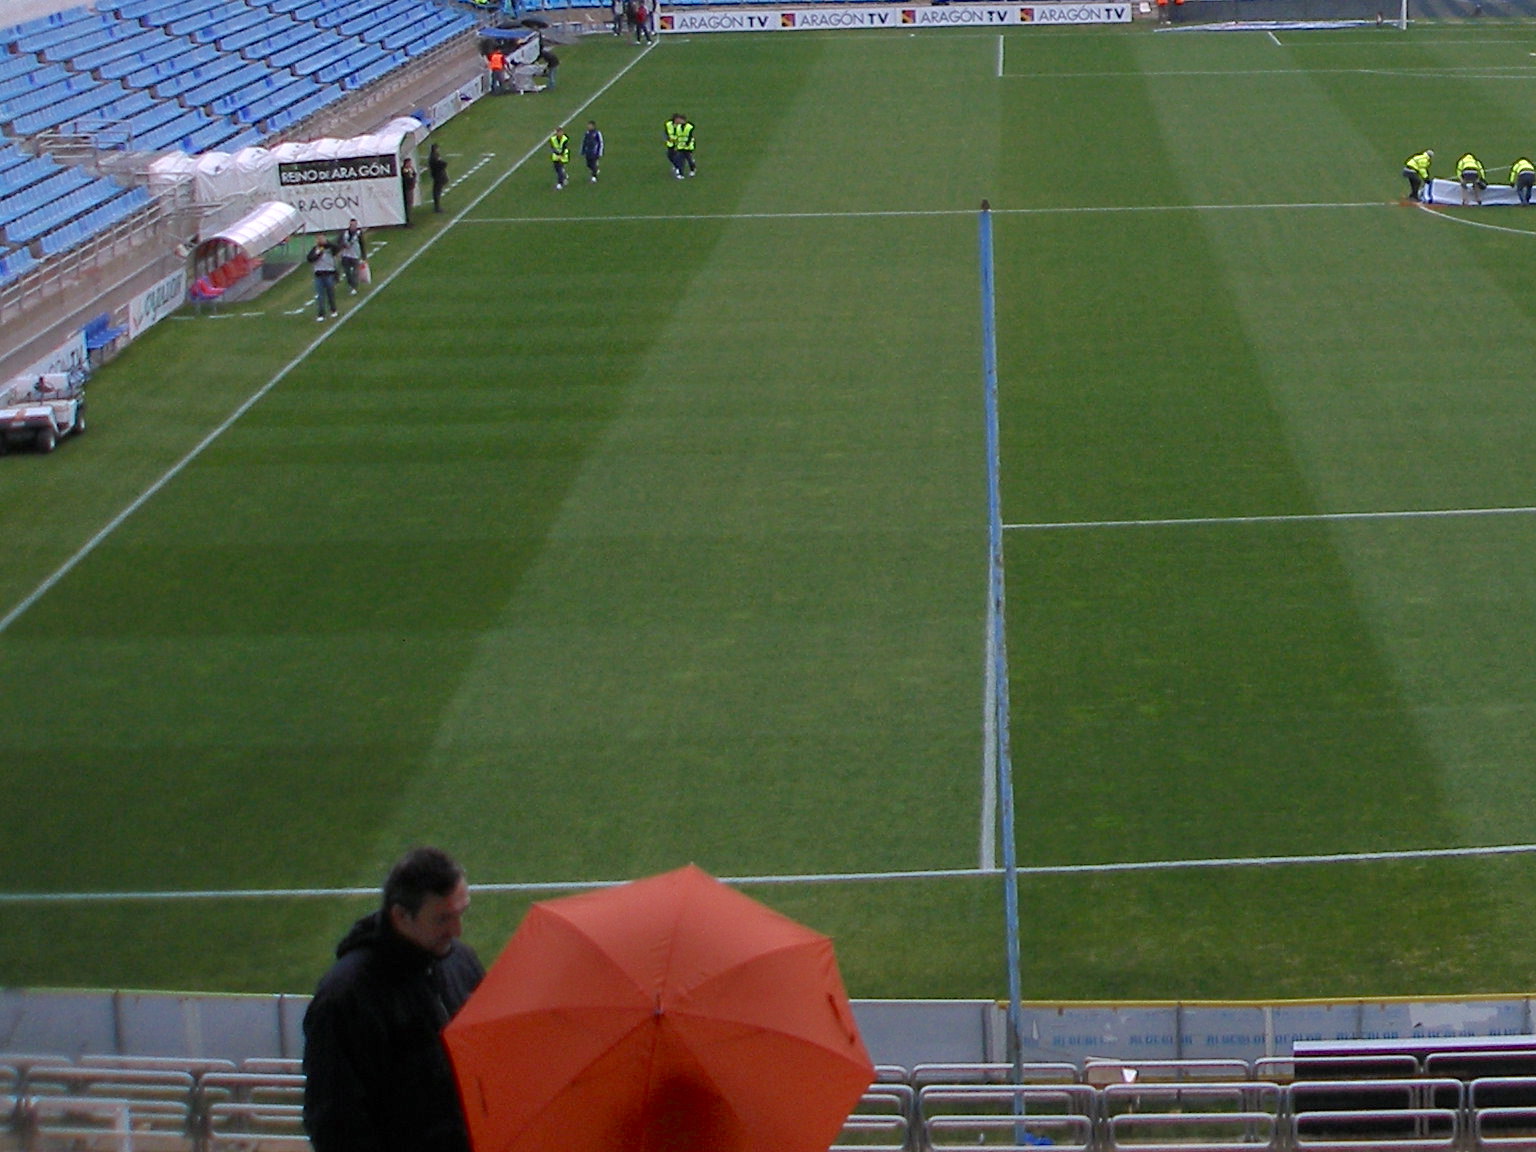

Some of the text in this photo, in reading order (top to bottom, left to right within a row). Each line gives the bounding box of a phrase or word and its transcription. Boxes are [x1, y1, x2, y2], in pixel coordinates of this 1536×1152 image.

[679, 14, 769, 29] ARAGÓN TV
[801, 11, 889, 27] ARAGÓN TV
[921, 8, 1008, 23] ARAGÓN TV
[1039, 6, 1125, 22] ARAGÓN TV
[282, 169, 319, 183] REINO
